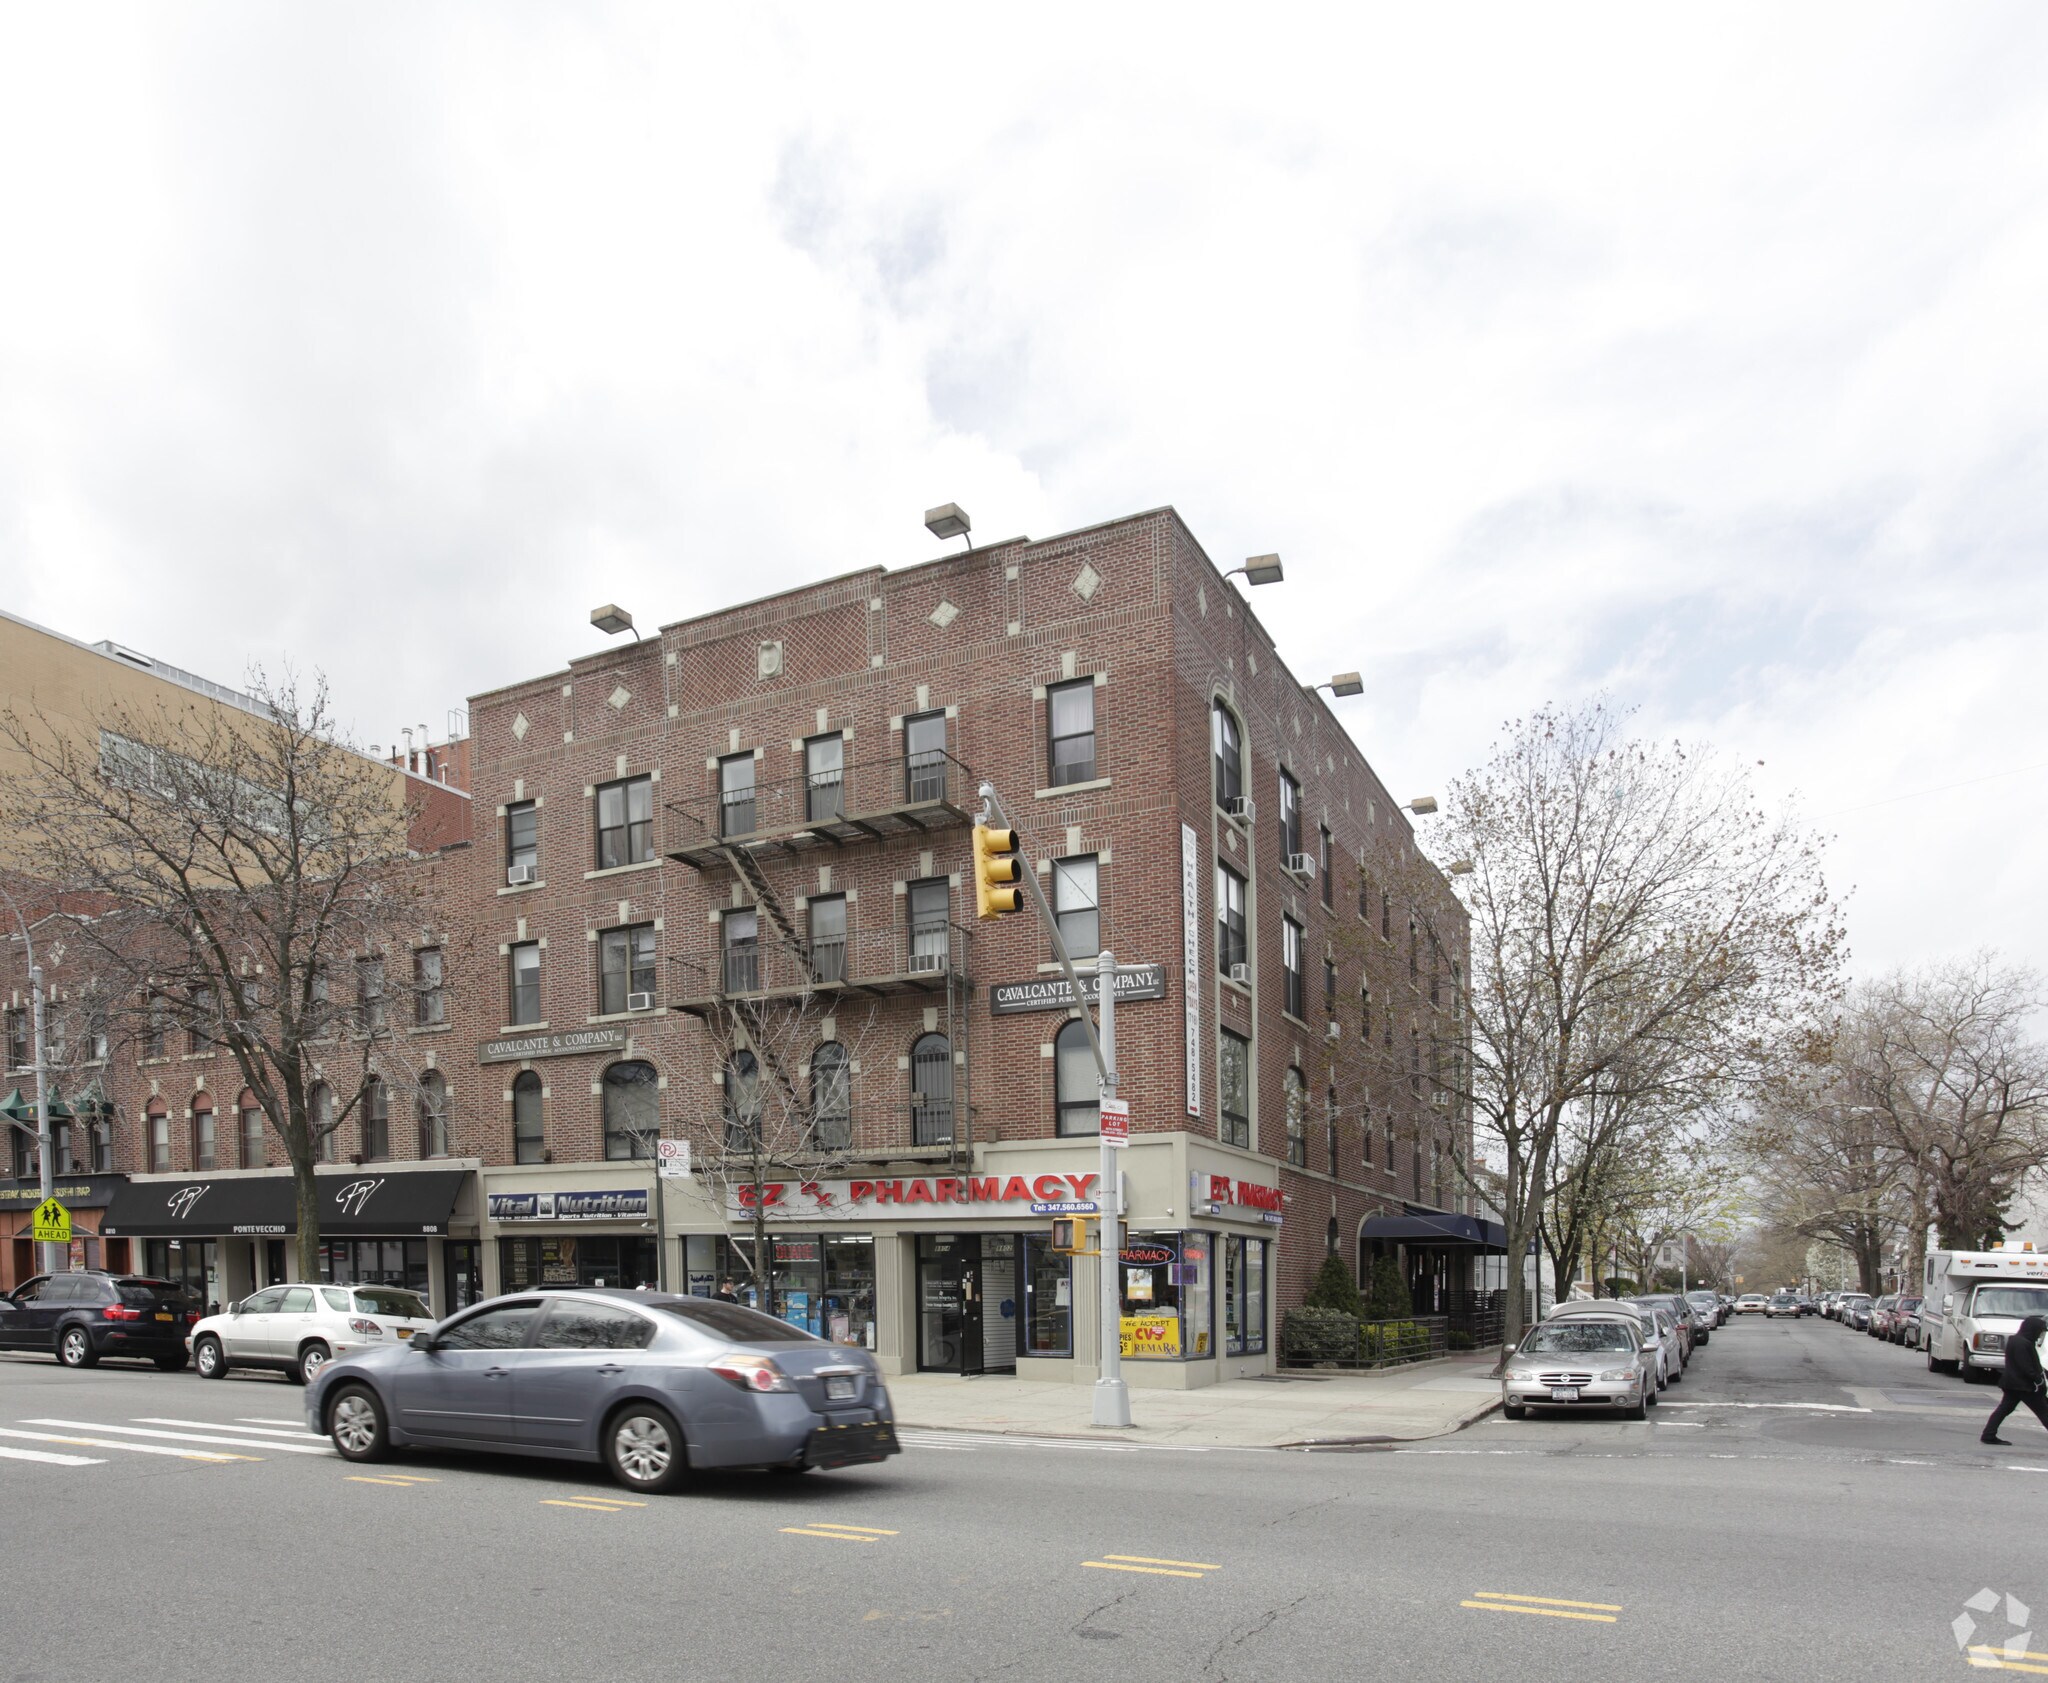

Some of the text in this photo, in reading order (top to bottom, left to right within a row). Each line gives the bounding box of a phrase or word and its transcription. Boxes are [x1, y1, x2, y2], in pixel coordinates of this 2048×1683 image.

[997, 980, 1072, 1002] CAVALCANTE
[1077, 979, 1087, 993] &
[1093, 972, 1154, 992] CMPANY
[1026, 998, 1057, 1007] CERTIFIED
[487, 1036, 549, 1055] CAVALCANTE
[552, 1036, 561, 1047] &
[565, 1030, 615, 1046] COMPANY
[512, 1050, 535, 1058] CERTIFIED
[1101, 1114, 1128, 1122] PARKING
[850, 1174, 1097, 1204] PHARMACY
[489, 1197, 534, 1214] Vital
[557, 1194, 648, 1214] Nutrition
[1033, 1202, 1094, 1212] Tel: 347.560.6560
[558, 1213, 580, 1221] Sports
[37, 1229, 68, 1240] AHEAD
[1119, 1332, 1132, 1342] PIES
[1135, 1328, 1163, 1341] CVS
